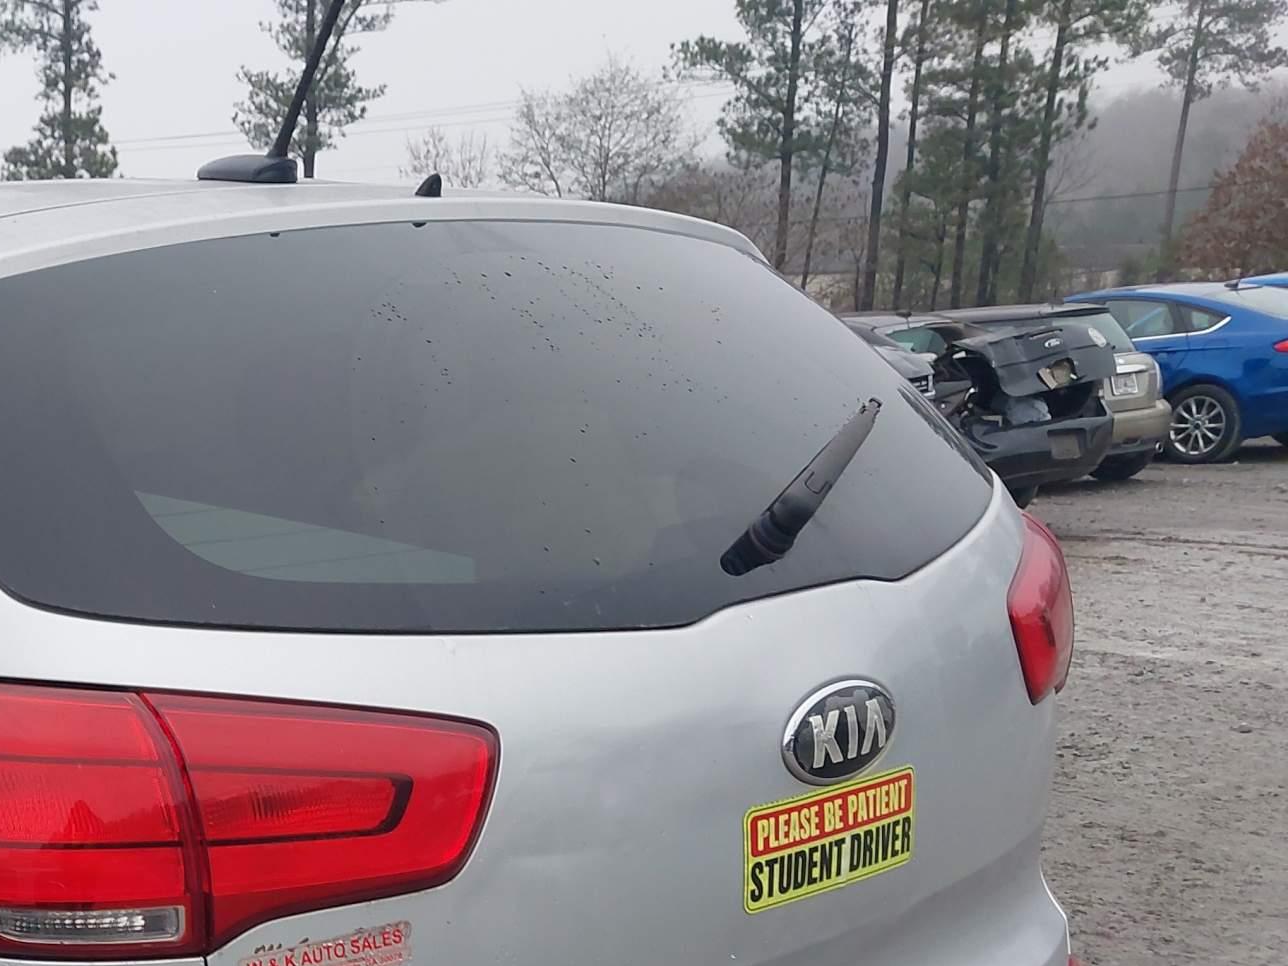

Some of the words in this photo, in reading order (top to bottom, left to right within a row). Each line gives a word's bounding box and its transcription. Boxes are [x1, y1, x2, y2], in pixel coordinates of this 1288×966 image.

[808, 698, 886, 769] KIA
[757, 806, 820, 852] PLEASE
[823, 798, 844, 833] BE
[848, 779, 908, 826] PATIENT
[750, 837, 846, 902] STUDENT
[849, 816, 911, 873] DRIVER
[301, 942, 346, 966] AUTO
[350, 928, 403, 955] SALES
